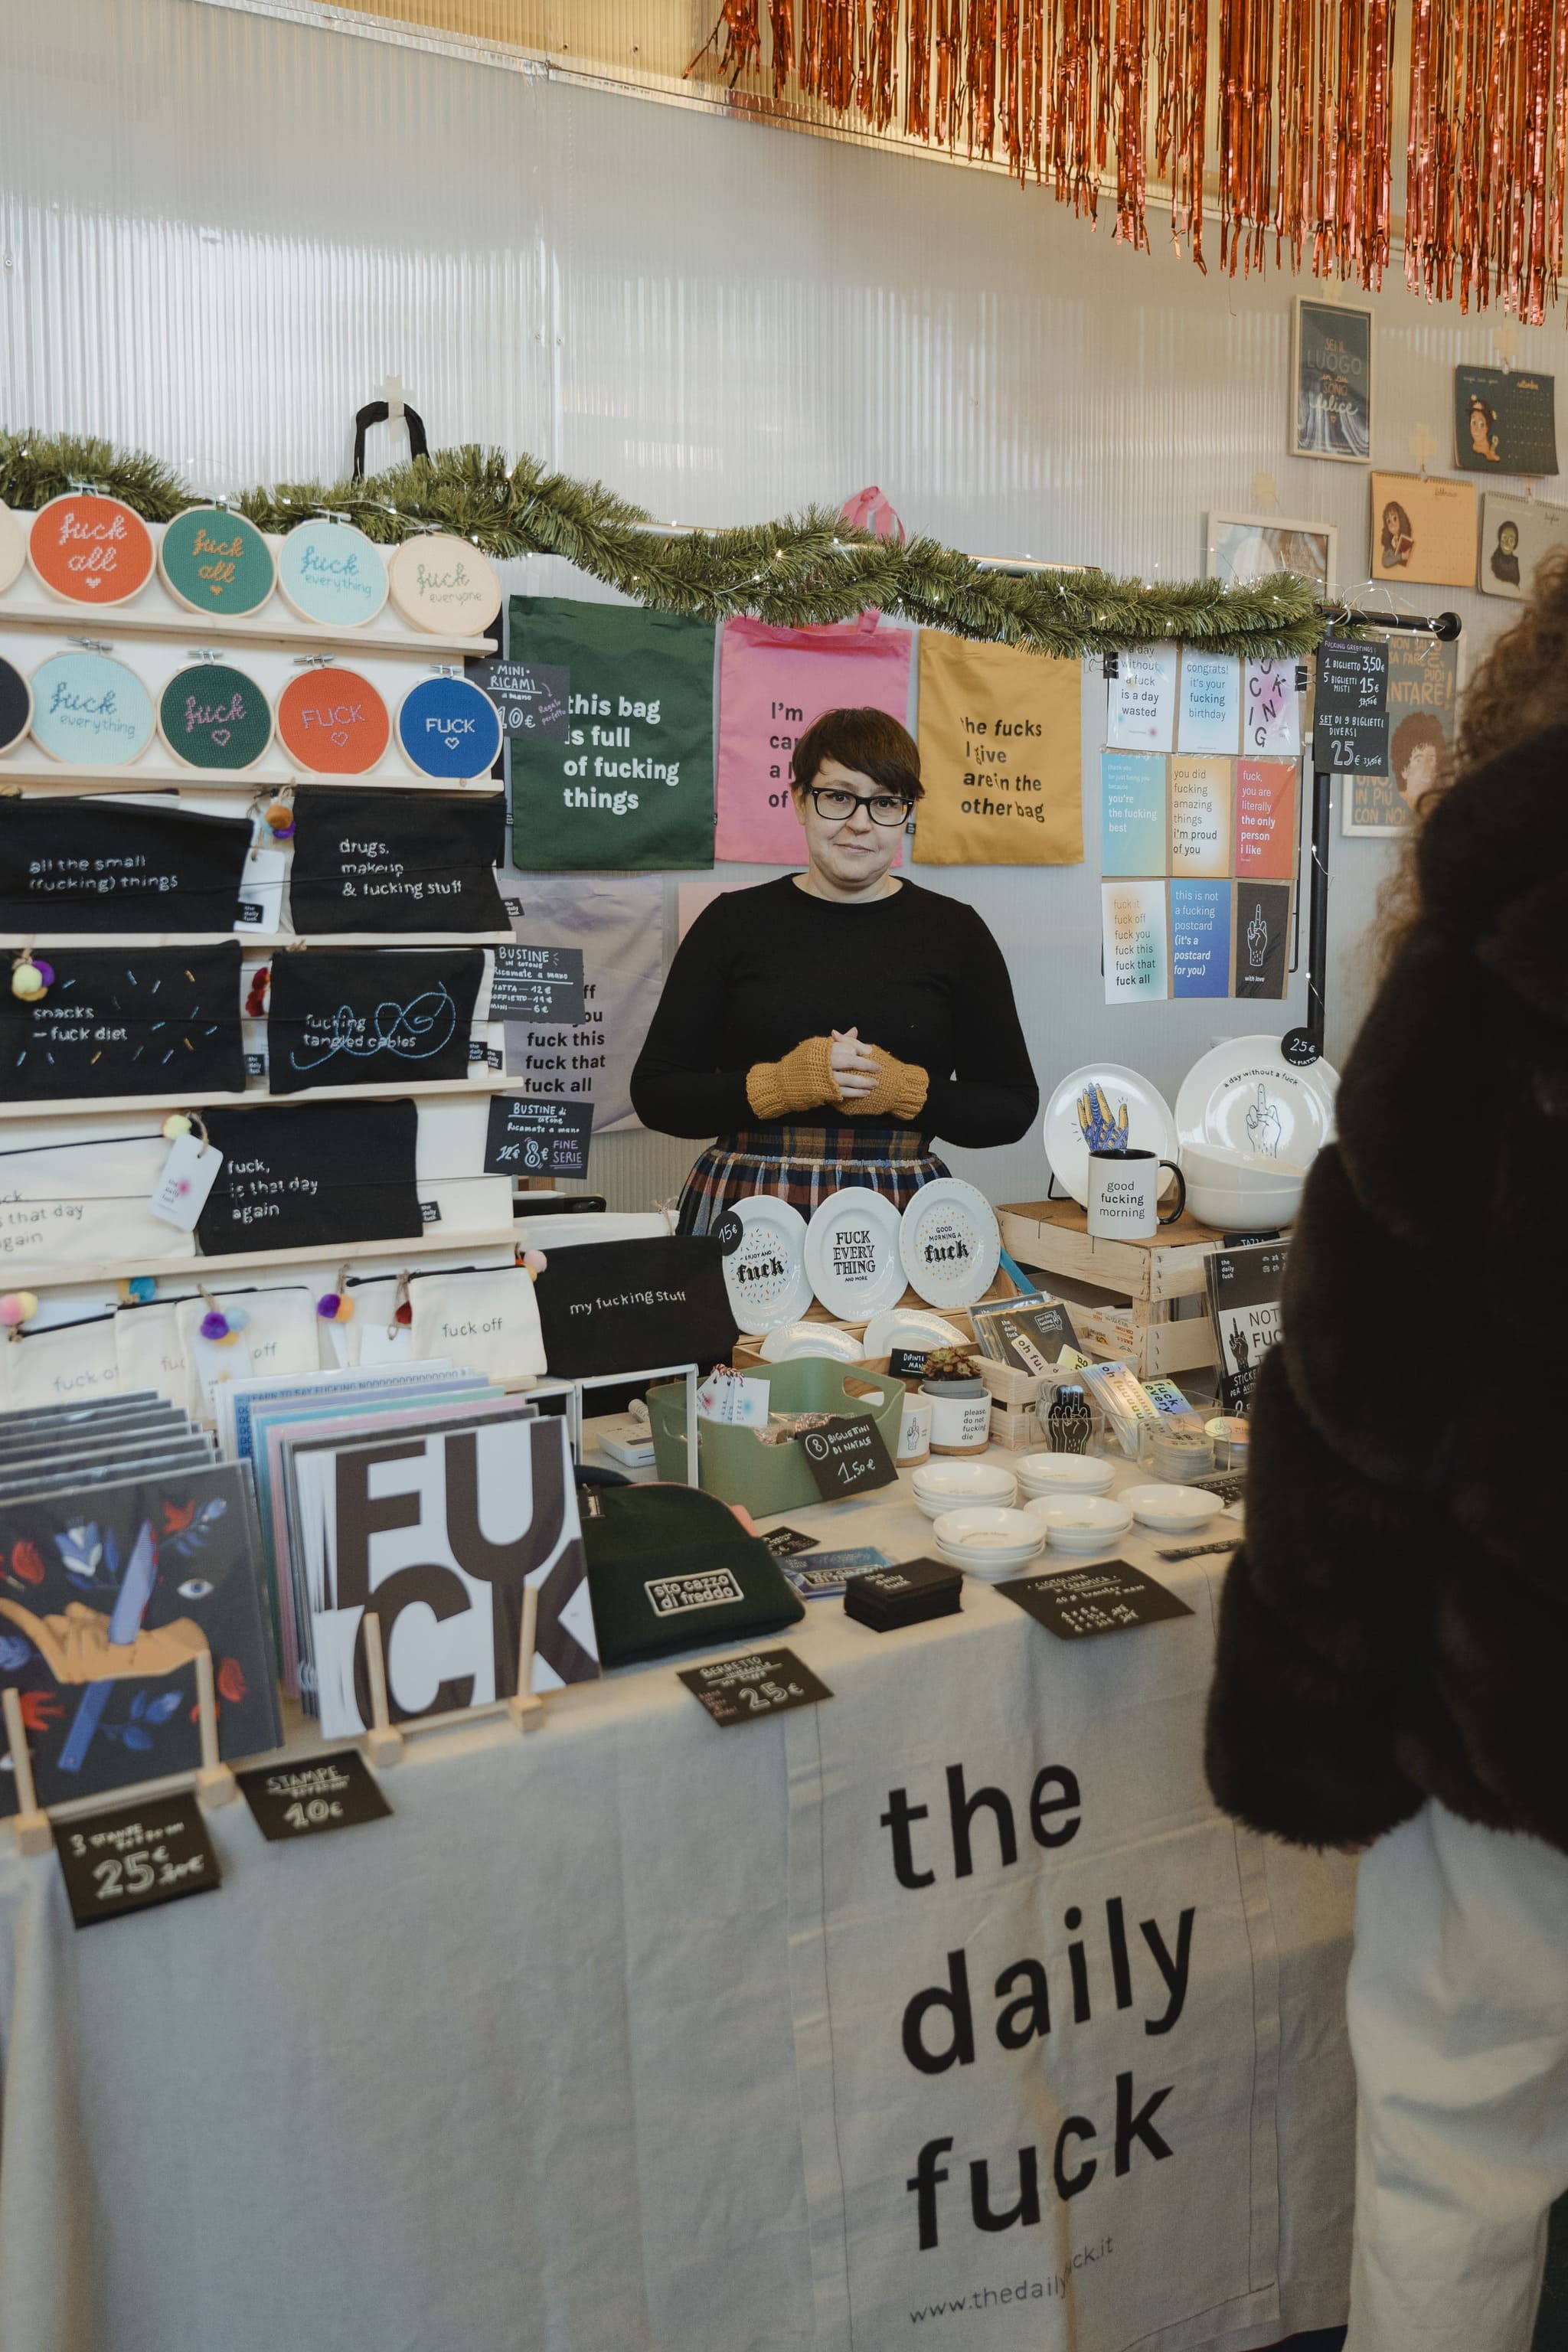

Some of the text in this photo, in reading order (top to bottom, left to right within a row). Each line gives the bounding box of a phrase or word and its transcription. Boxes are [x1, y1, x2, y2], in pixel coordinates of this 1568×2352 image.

[1307, 350, 1361, 374] LUOGO
[59, 513, 126, 545] fuck
[191, 530, 243, 558] fuck
[68, 547, 116, 572] all
[301, 546, 359, 577] fuck
[199, 562, 236, 583] all
[416, 564, 470, 592] fuck
[305, 574, 372, 597] everything
[1187, 663, 1229, 675] congrats!
[1325, 658, 1331, 668] 1
[1333, 660, 1361, 671] BIGLIETTO
[491, 677, 536, 691] RICAMI
[1135, 677, 1155, 686] fuck
[1324, 674, 1329, 683] 5
[1331, 676, 1357, 685] BIGLIETTI
[1334, 684, 1350, 693] MISTI
[50, 681, 116, 716] fuck
[1191, 694, 1225, 707] fucking
[185, 693, 246, 730] fuck
[302, 704, 362, 729] FUCK
[619, 696, 661, 724] bag
[1122, 707, 1156, 717] wasted
[1189, 708, 1225, 721] birthday
[60, 713, 136, 740] everything
[426, 717, 475, 734] FUCK
[1320, 715, 1332, 724] SET
[1345, 717, 1349, 725] 9
[1352, 717, 1383, 727] BIGLIETTI
[1330, 728, 1357, 737] DIVERSI
[564, 756, 679, 786] of fucking
[1174, 769, 1206, 780] you did
[1015, 775, 1042, 792] the
[1174, 784, 1207, 796] fucking
[1109, 793, 1133, 805] you're
[1243, 788, 1256, 797] you
[564, 786, 639, 815] things
[1174, 801, 1212, 812] amazing
[1243, 802, 1271, 813] literally
[961, 798, 1045, 823] other bag
[1109, 808, 1157, 821] the fucking
[1109, 823, 1127, 832] best
[1174, 815, 1202, 826] things
[1242, 816, 1276, 829] the only
[1174, 831, 1217, 840] i'm proud
[1241, 831, 1270, 841] person
[1184, 846, 1200, 856] you
[95, 854, 146, 871] small
[343, 883, 357, 897] &
[364, 882, 423, 900] fucking
[1176, 890, 1219, 900] this is not
[1182, 906, 1215, 918] fucking
[1175, 921, 1212, 932] postcard
[1116, 929, 1150, 942] fuck you
[499, 947, 549, 963] BUSTINE
[1116, 944, 1153, 955] fuck this
[1174, 951, 1210, 961] postcard
[1116, 959, 1155, 970] fuck that
[1174, 965, 1205, 977] for you)
[1116, 975, 1150, 985] fuck all
[51, 1027, 128, 1041] fuck diet
[528, 1031, 605, 1047] fuck this
[1289, 1038, 1315, 1054] 25€
[526, 1054, 606, 1070] fuck that
[524, 1077, 592, 1093] fuck all
[1229, 1074, 1242, 1085] day
[1243, 1070, 1274, 1079] without
[1282, 1073, 1298, 1086] fuck
[514, 1102, 557, 1115] BUSTINE
[553, 1140, 579, 1149] FINE
[553, 1152, 583, 1163] SERIE
[1107, 1181, 1135, 1192] good
[1101, 1193, 1145, 1207] fucking
[1099, 1207, 1145, 1219] morning
[836, 1230, 871, 1245] FUCK
[929, 1233, 956, 1241] MORNING
[833, 1245, 874, 1260] EVERY
[924, 1240, 969, 1263] fuck
[737, 1257, 784, 1283] fuck
[833, 1260, 875, 1276] THING
[570, 1302, 592, 1315] my
[596, 1291, 653, 1309] fucking
[443, 1318, 503, 1338] fuck off
[828, 1424, 870, 1444] BIGLIETTINI
[833, 1436, 871, 1455] DI NATALE
[654, 1573, 729, 1597] sto cazzo
[661, 1585, 734, 1609] di freddo
[700, 1655, 763, 1679] BERRETTO
[266, 1765, 340, 1792] STAMPE
[880, 1762, 1081, 1890] the
[902, 1896, 1196, 2075] daily
[906, 2070, 1175, 2252] fuck
